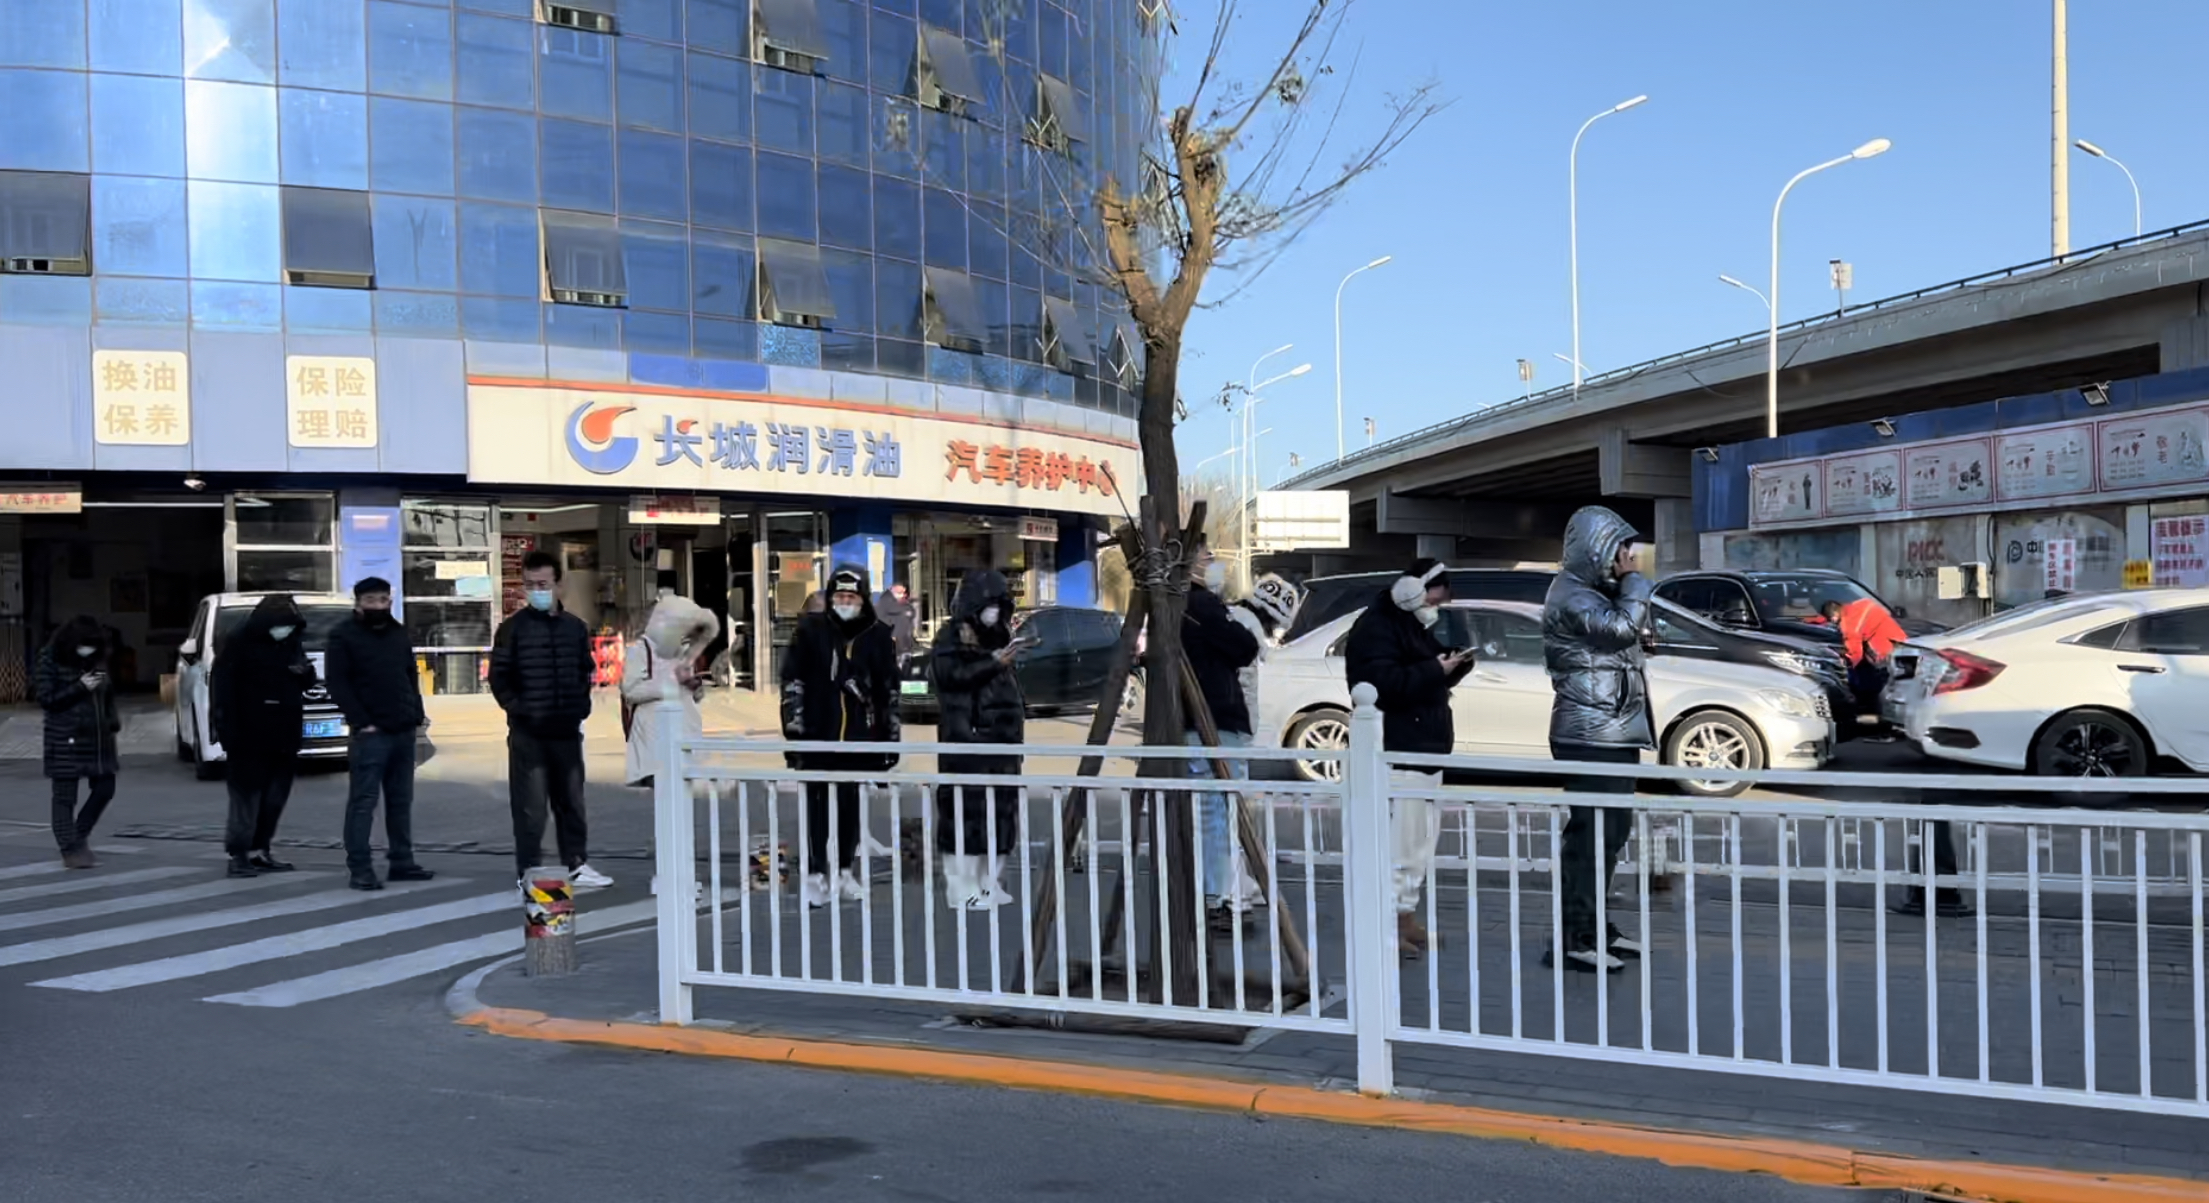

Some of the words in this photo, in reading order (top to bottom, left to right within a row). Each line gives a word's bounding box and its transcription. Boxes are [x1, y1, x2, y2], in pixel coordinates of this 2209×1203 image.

[102, 360, 177, 392] 换油
[296, 365, 367, 397] 保险
[103, 403, 179, 435] 保养
[296, 408, 368, 439] 理赔
[654, 414, 900, 478] 长城润滑油
[945, 440, 1117, 497] 汽车养护中心
